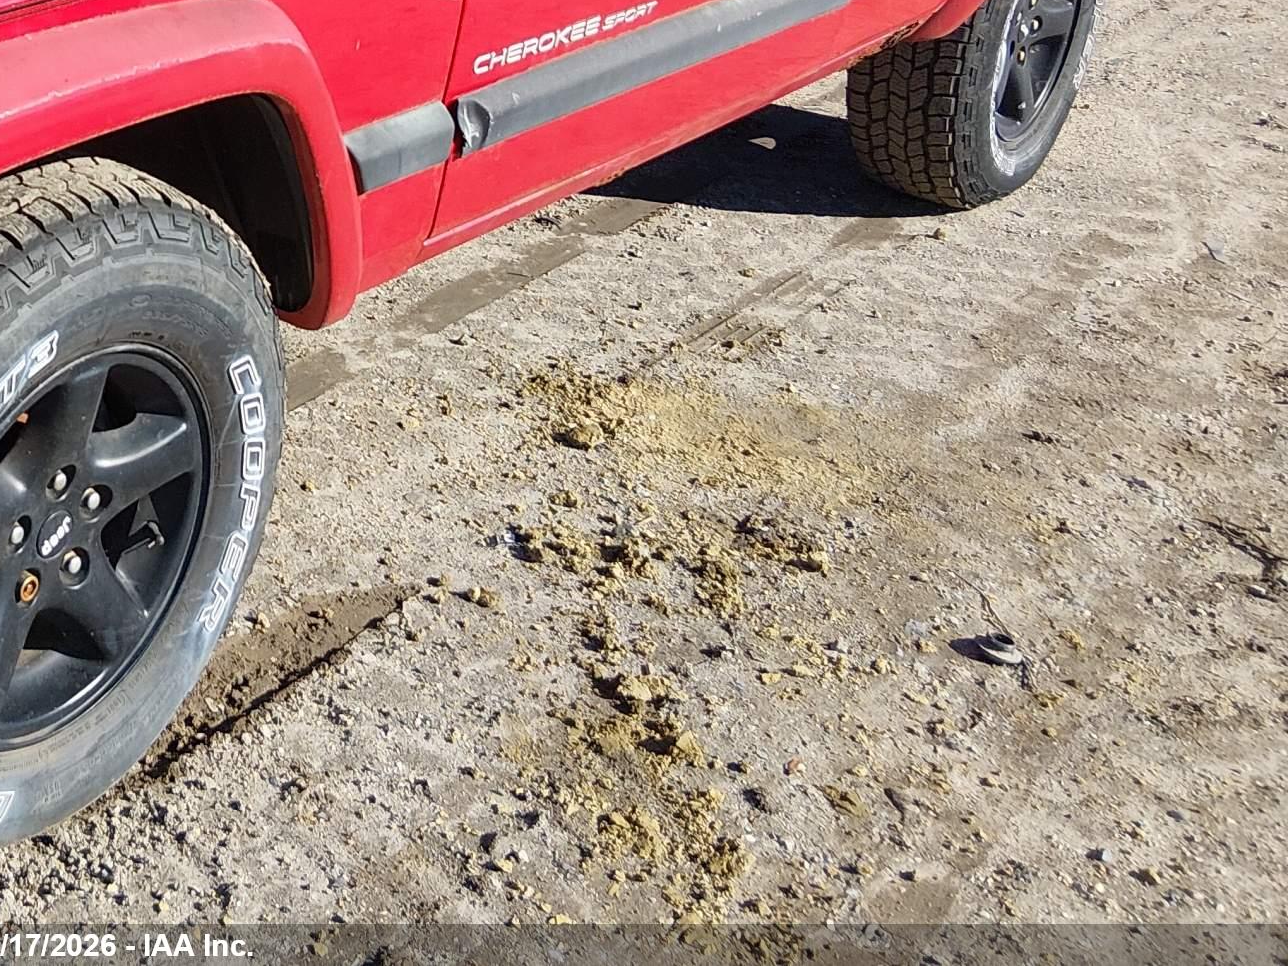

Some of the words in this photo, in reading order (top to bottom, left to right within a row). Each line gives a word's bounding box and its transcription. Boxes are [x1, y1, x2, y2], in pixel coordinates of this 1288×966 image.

[472, 14, 602, 75] CHEROKEE
[601, 0, 659, 31] SPORT
[198, 354, 267, 632] COOPER
[41, 515, 71, 557] Jeep
